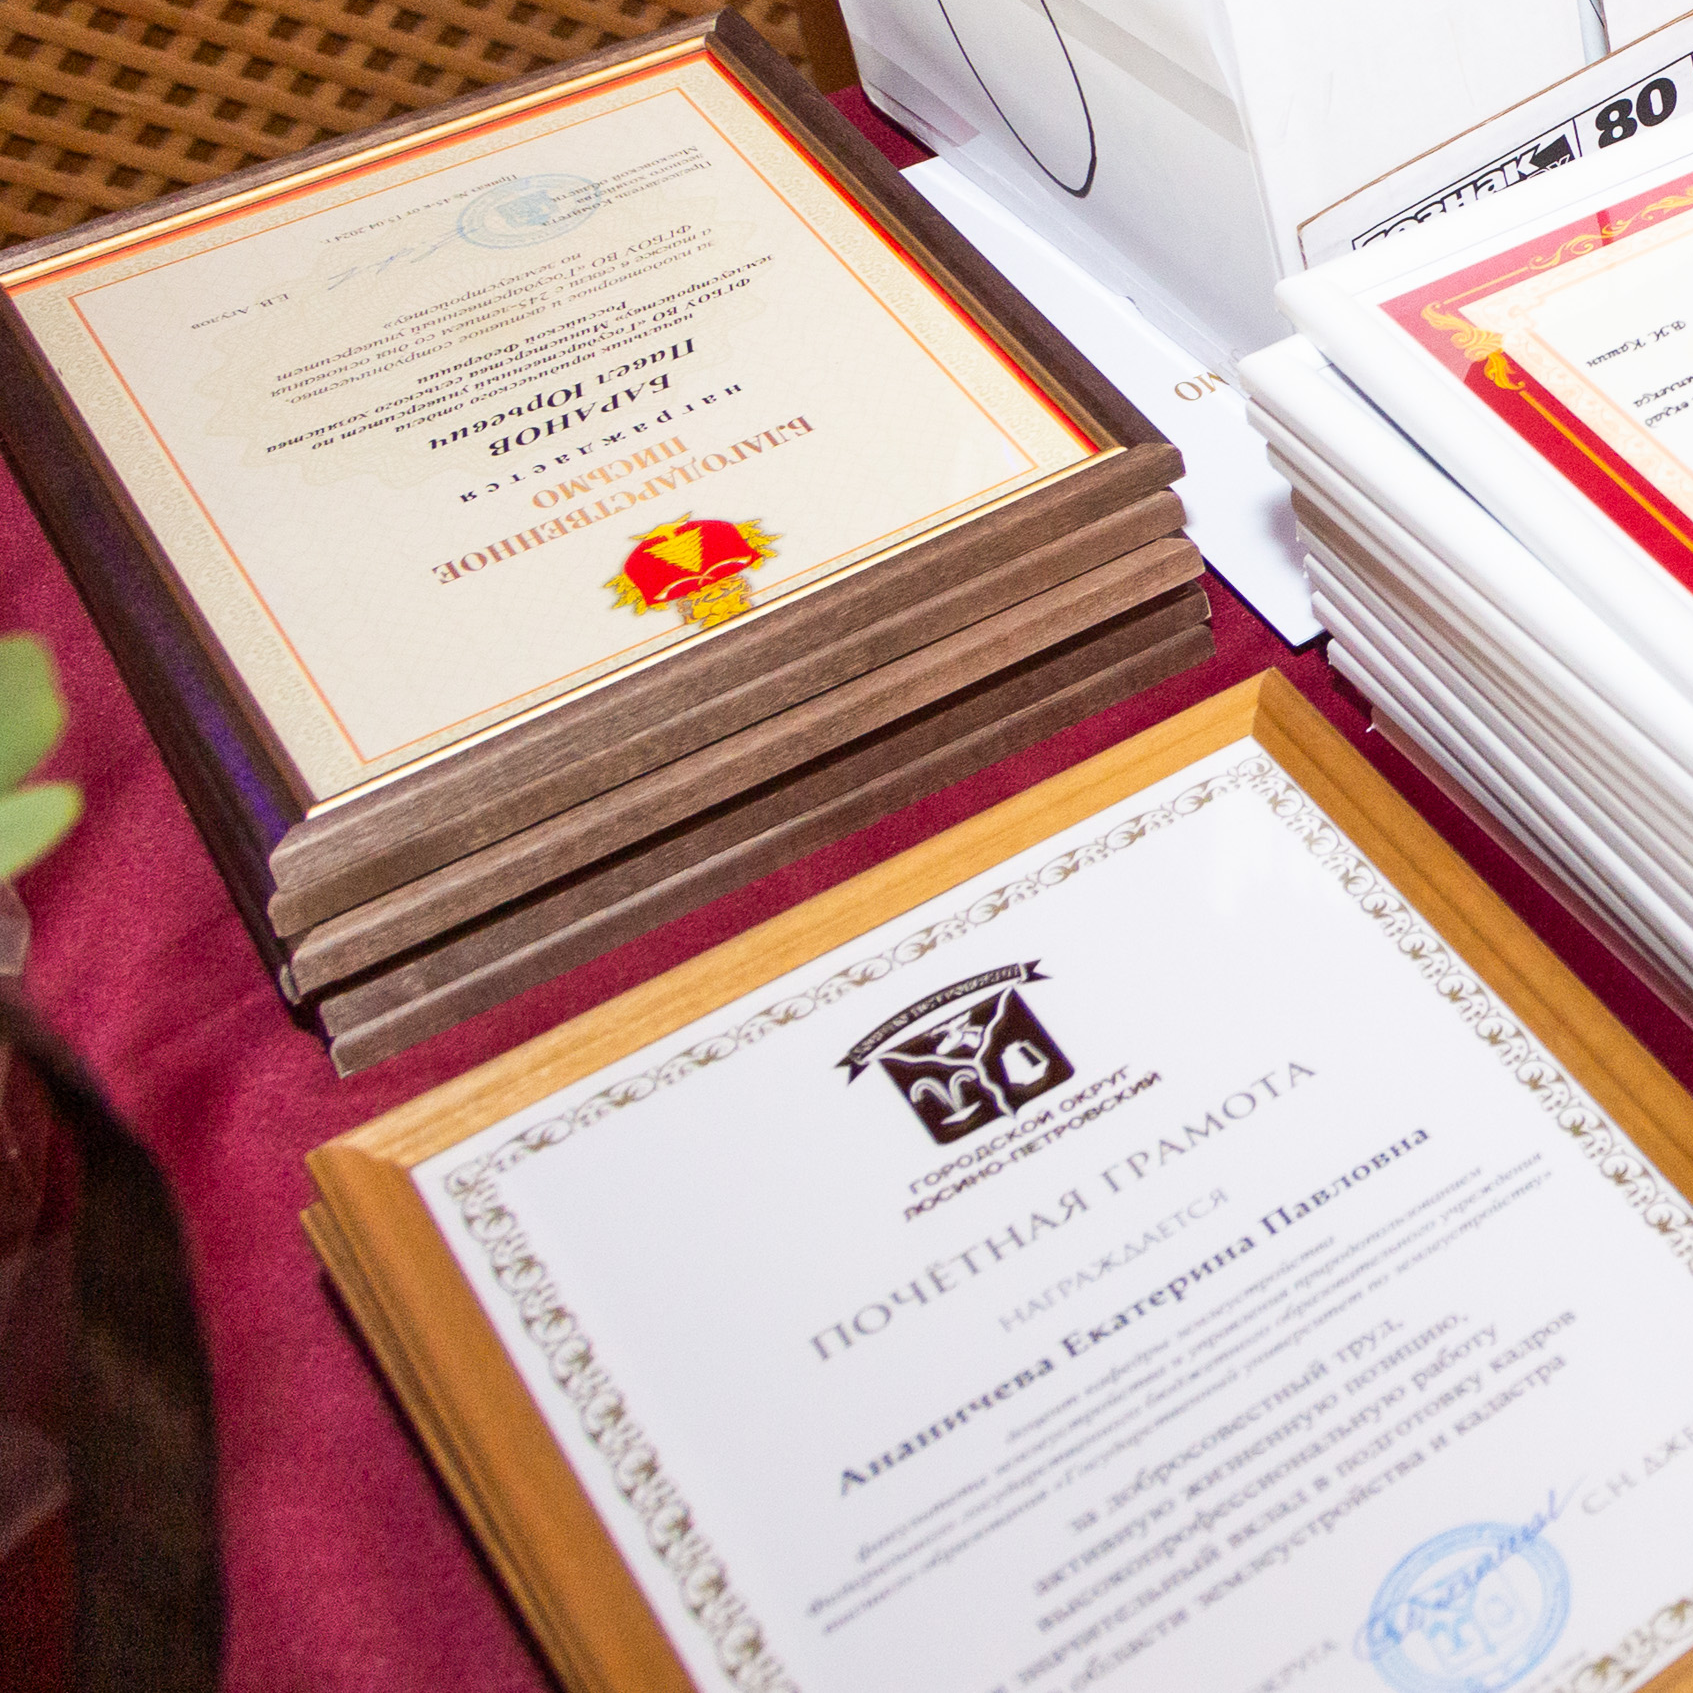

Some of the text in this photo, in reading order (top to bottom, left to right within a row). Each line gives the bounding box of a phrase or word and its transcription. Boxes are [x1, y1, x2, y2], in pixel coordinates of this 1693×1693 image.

[1593, 75, 1678, 150] 80
[188, 304, 250, 330] Агулов
[543, 297, 563, 309] и
[650, 304, 679, 323] ВО
[684, 277, 751, 310] ФГБОУ
[415, 299, 627, 385] Российской Федерации
[457, 304, 547, 344] активное
[467, 319, 610, 379] Министерства
[599, 311, 694, 354] начальник
[372, 375, 464, 414] сельского
[427, 336, 695, 450] Павел Юрьевич
[468, 350, 596, 405] юридического
[264, 409, 369, 454] хозяйства
[338, 383, 470, 440] университет
[487, 372, 671, 457] БАРАНОВ
[309, 435, 335, 451] по
[530, 434, 690, 509] ПИСЬМО
[429, 414, 815, 585] БЛАГОДАРСТВЕННОЕ
[1098, 1060, 1317, 1195] ГРАМОТА
[996, 1186, 1230, 1334] НАГРАЖДАЕТСЯ
[839, 1127, 1431, 1497] Ананичева Екатерина Павловна
